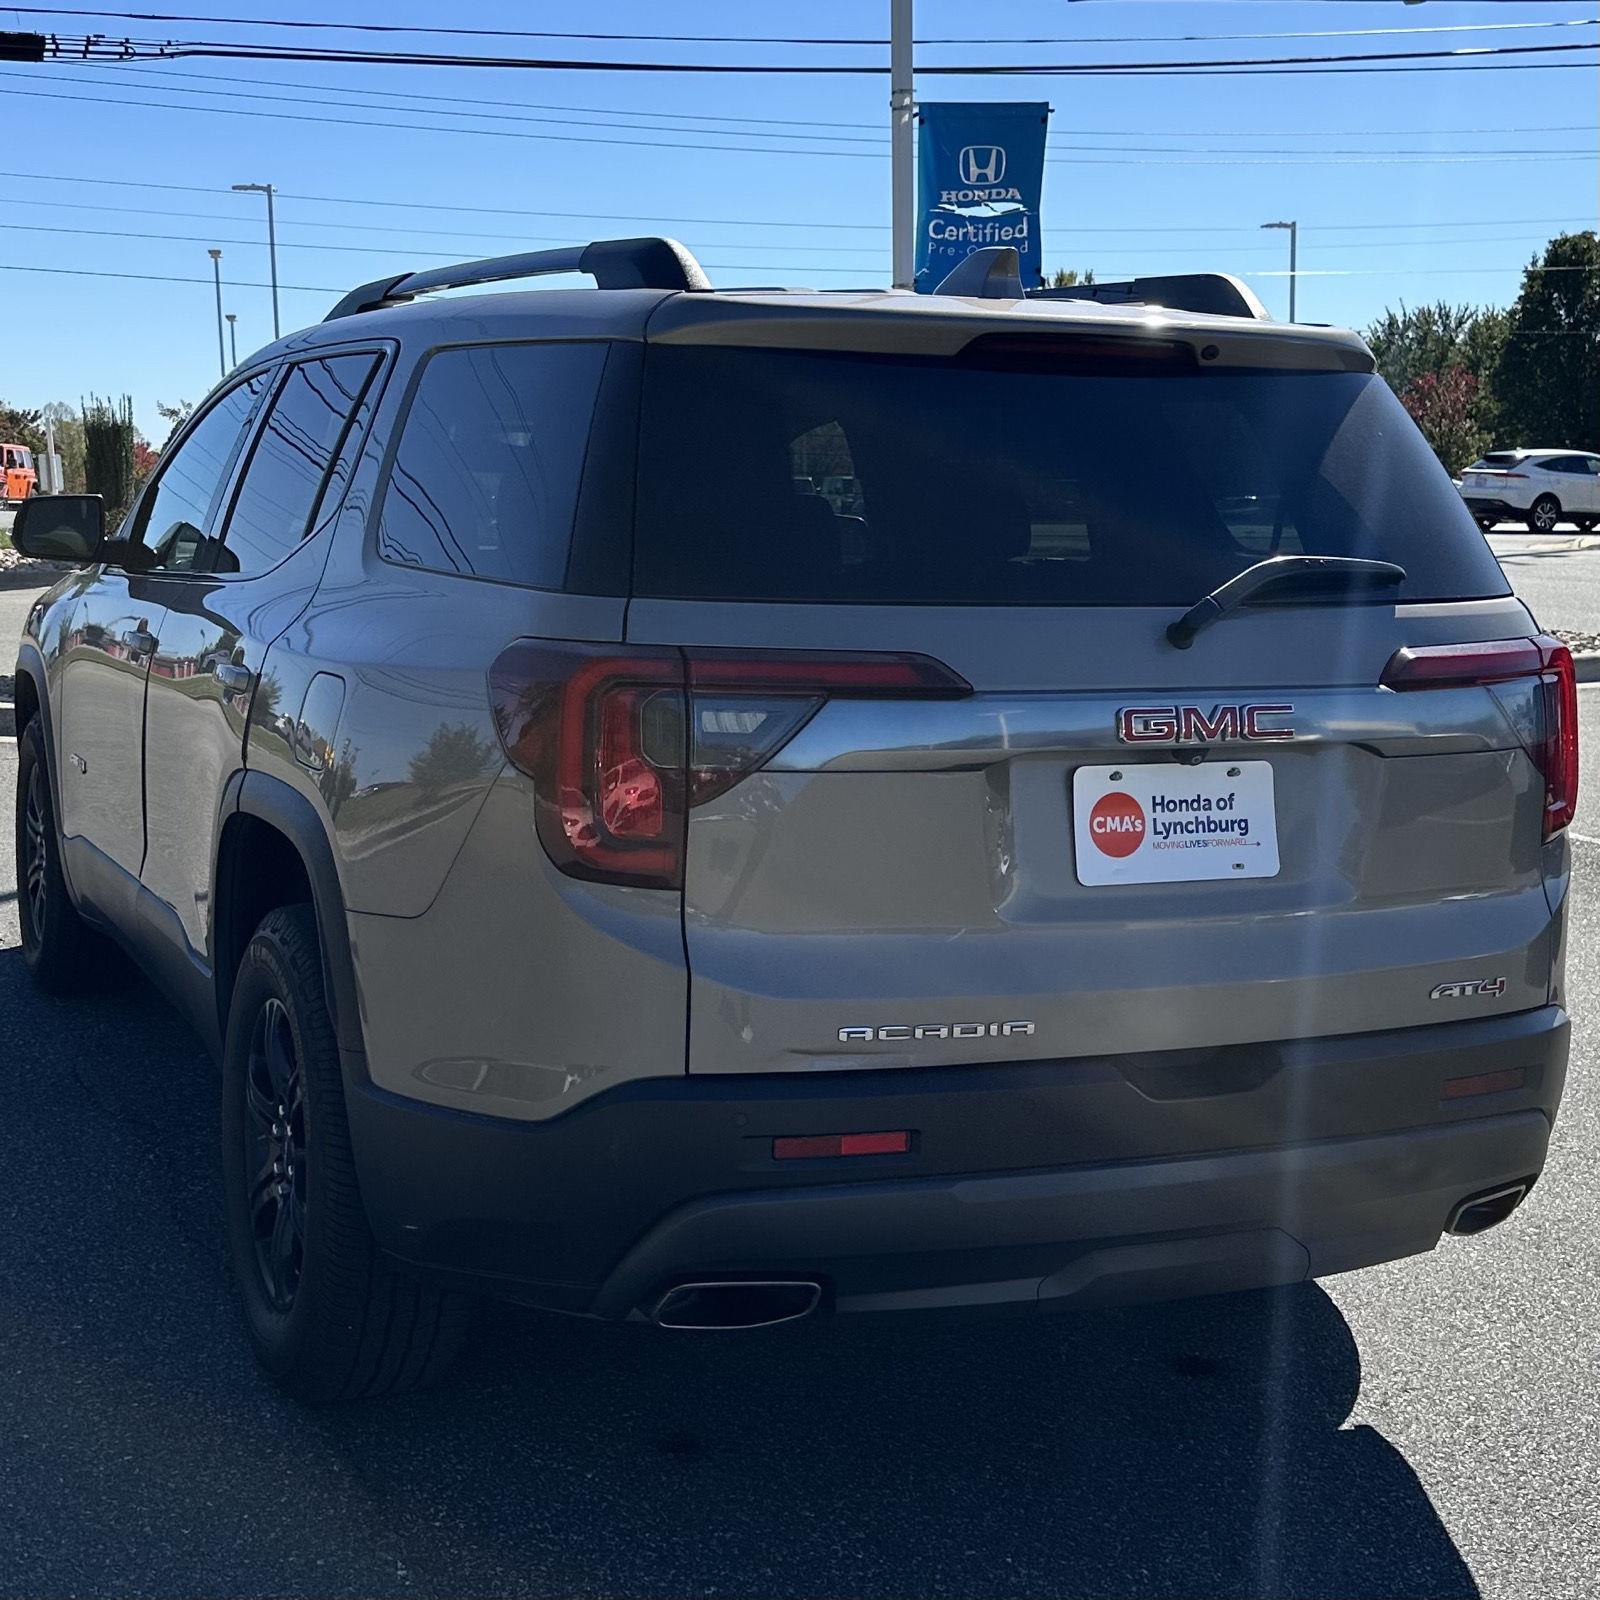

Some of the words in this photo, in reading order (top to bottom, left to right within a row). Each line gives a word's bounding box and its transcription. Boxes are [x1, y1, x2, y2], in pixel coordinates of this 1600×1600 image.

[940, 187, 1022, 202] HONDA
[928, 216, 1028, 243] Certified
[928, 240, 1028, 257] Pre-Od
[1117, 703, 1295, 744] GMC
[1152, 794, 1212, 813] Honda
[1216, 792, 1235, 811] of
[1092, 815, 1143, 834] CMA's
[1152, 815, 1249, 840] Lynchburg
[1430, 977, 1507, 999] AT4
[838, 1020, 1035, 1042] ACADIA
